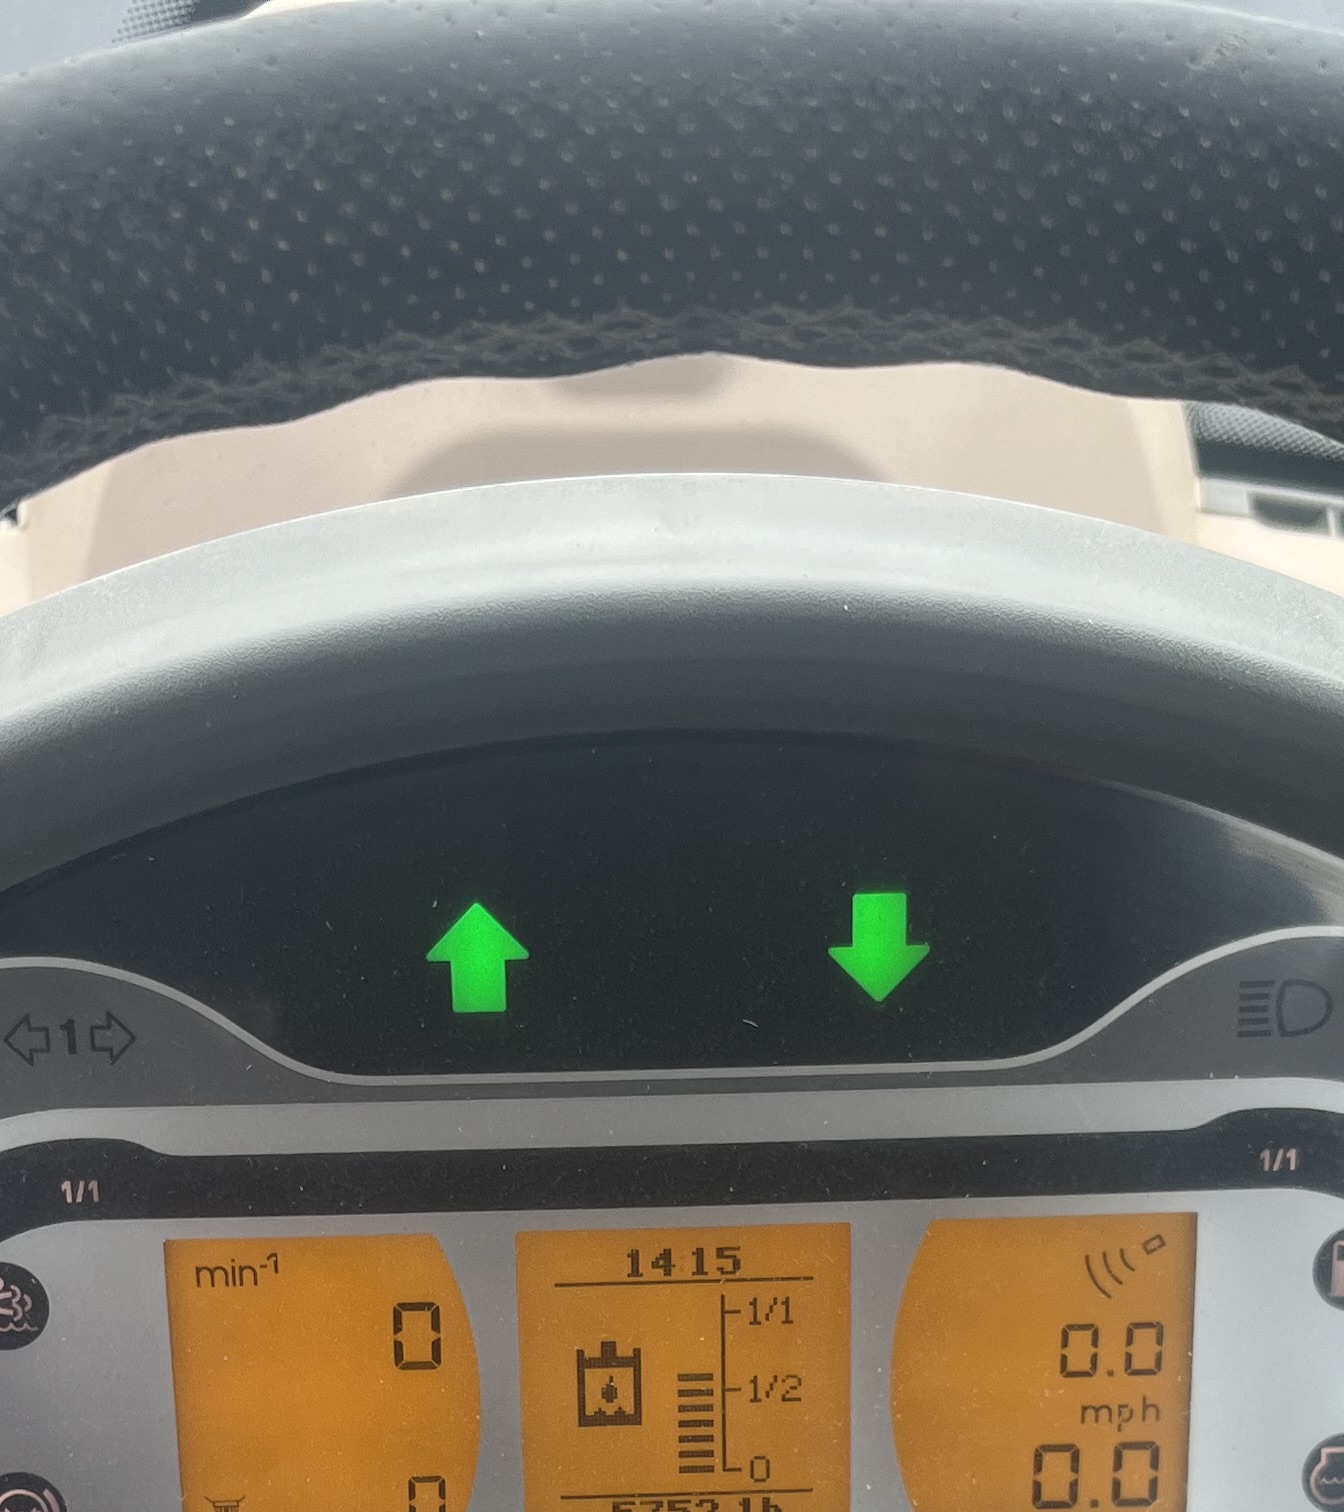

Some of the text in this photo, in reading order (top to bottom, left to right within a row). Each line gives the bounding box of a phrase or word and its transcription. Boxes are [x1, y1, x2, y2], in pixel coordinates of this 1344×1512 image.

[1259, 1149, 1298, 1172] 1/1
[60, 1179, 100, 1203] 1/1
[749, 1296, 794, 1325] 1/1
[393, 1302, 442, 1371] 0
[1060, 1322, 1164, 1378] 0.0
[749, 1374, 802, 1403] 1/2
[1080, 1396, 1160, 1432] mph
[749, 1455, 771, 1483] 0
[1032, 1441, 1160, 1509] 0.0
